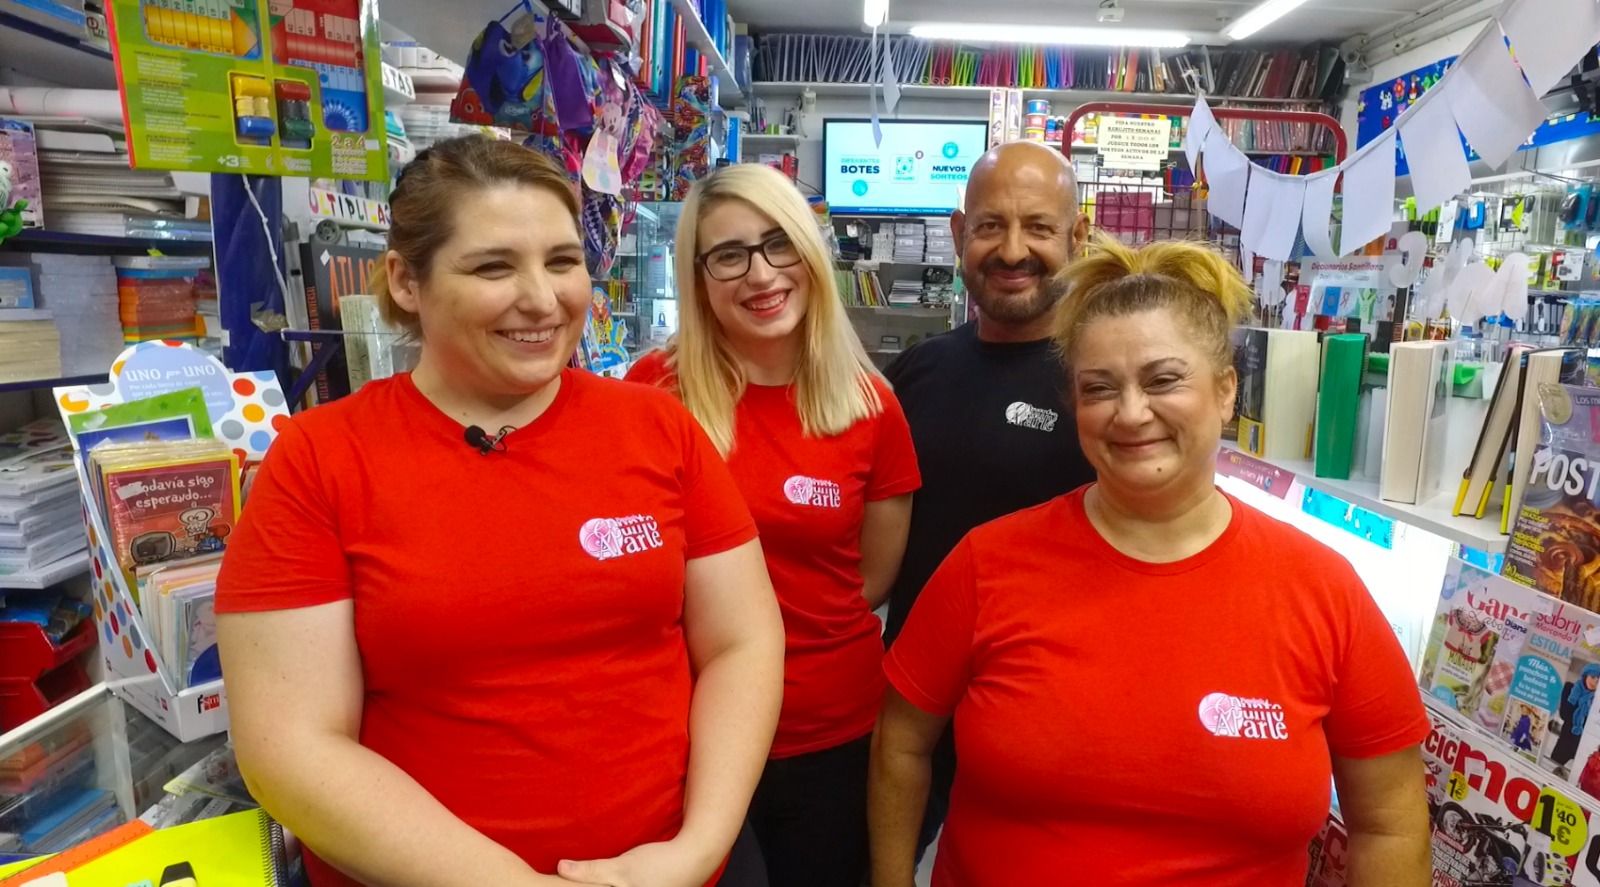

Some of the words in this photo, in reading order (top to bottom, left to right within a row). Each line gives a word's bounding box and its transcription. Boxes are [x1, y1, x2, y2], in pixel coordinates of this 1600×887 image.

[840, 165, 880, 175] BOTES
[932, 165, 967, 173] NUEVOS
[125, 368, 161, 383] UNO
[182, 364, 216, 378] UNO
[1505, 618, 1528, 635] Diana
